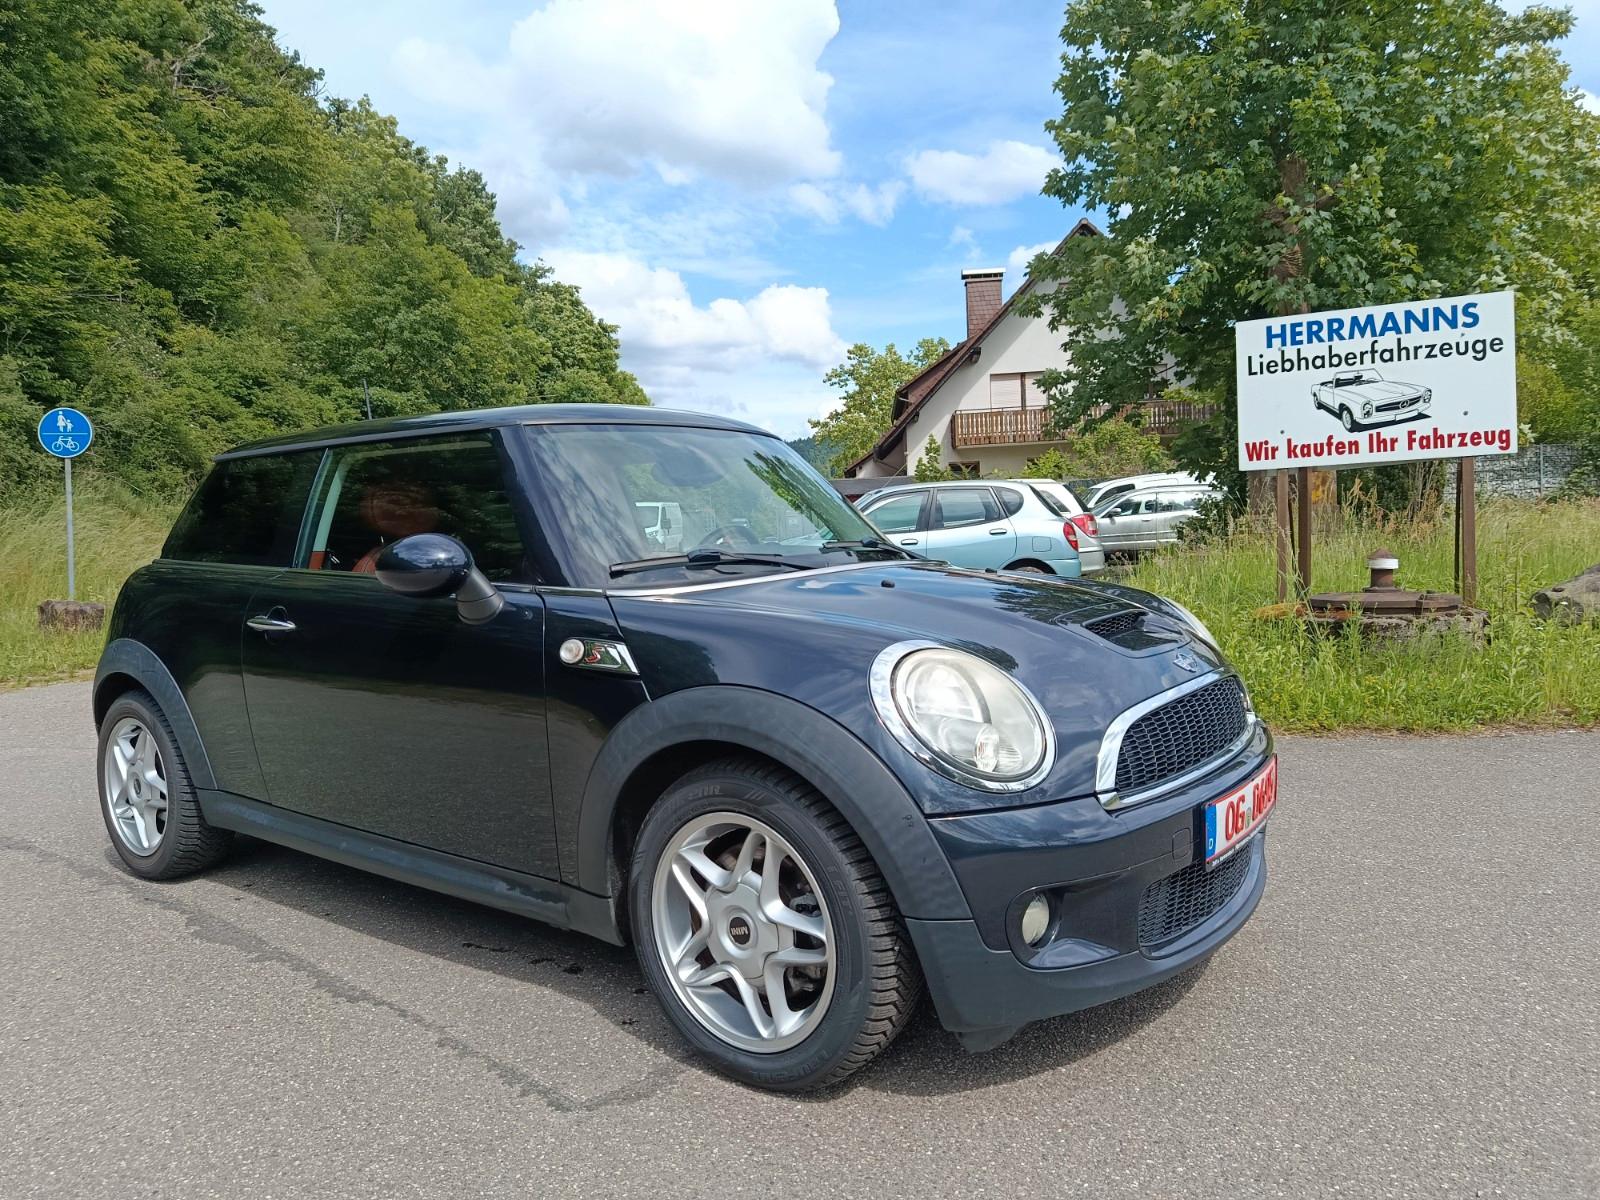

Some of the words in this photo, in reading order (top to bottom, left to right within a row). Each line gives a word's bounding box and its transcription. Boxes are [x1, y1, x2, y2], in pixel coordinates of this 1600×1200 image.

[1265, 303, 1481, 350] HERRMANNS
[1247, 337, 1504, 376] Liebhaberfahrzeuge
[1245, 441, 1279, 462] Wir
[1286, 435, 1360, 459] kaufen
[1368, 431, 1399, 453] Ihr
[1407, 428, 1511, 451] Fahrzeug
[1225, 794, 1246, 841] OG
